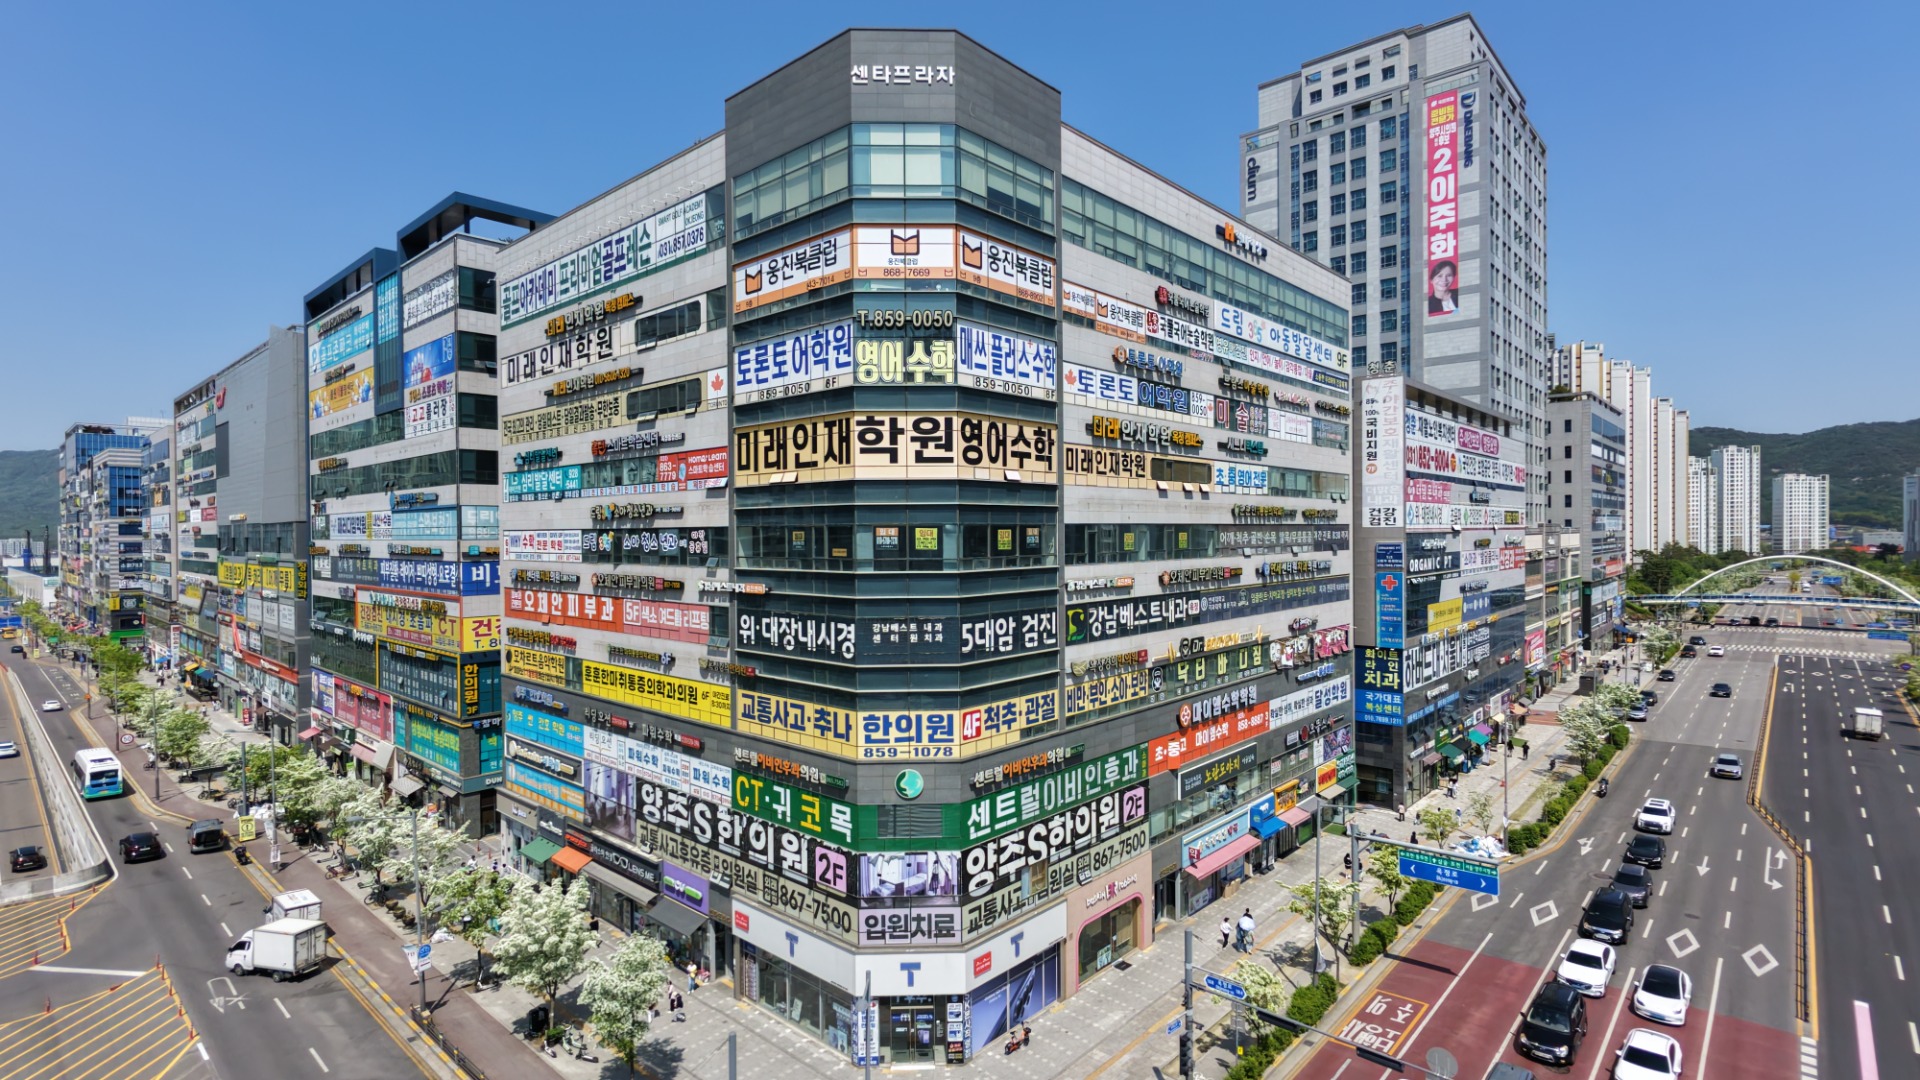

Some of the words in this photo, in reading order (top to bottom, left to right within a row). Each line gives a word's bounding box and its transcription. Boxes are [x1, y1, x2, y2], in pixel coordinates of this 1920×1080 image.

[850, 64, 956, 85] 센타프라자
[1463, 109, 1474, 169] DAEBANG
[1433, 147, 1453, 174] 2
[1430, 173, 1457, 260] 이주화
[766, 238, 837, 286] 웅진북클럽
[883, 268, 930, 278] 868-7669
[987, 244, 1053, 289] 웅진북클럽
[856, 309, 953, 328] T.859-0050
[1109, 303, 1144, 328] 웅진북클럽
[1221, 307, 1243, 337] 드림
[1269, 326, 1333, 362] 아동발달센터
[1336, 351, 1347, 369] 9F
[507, 325, 613, 383] 미래인재학원
[855, 339, 956, 385] 영어수학
[959, 326, 1056, 387] 매쓰플러스수학
[1127, 348, 1155, 371] 토론토
[1158, 355, 1183, 378] 어학원
[1367, 360, 1397, 375] 청춘
[759, 382, 810, 400] 859-0050
[825, 377, 838, 389] 8F
[974, 376, 1031, 396] 859-0050
[1045, 389, 1056, 399] 8F
[1191, 404, 1208, 417] 0050
[1216, 398, 1249, 433] 미술
[1093, 415, 1172, 446] 미래인재학원
[1172, 429, 1202, 447] 옥정캠퍼스
[1366, 417, 1378, 461] 국비지원
[659, 471, 677, 480] 7779
[688, 462, 725, 474] 스마트학습센터
[1065, 447, 1146, 478] 미래인재학원
[521, 469, 563, 491] 심리발달센터
[1368, 507, 1398, 517] 건강
[1368, 516, 1398, 527] 검진
[522, 533, 535, 550] 수학
[582, 533, 597, 551] 드림
[1410, 557, 1442, 573] ORGANIC
[1443, 555, 1453, 569] PT
[597, 575, 655, 590] 오체안피부과의원
[524, 592, 614, 621] 오체안피부과
[625, 602, 640, 622] 5F
[641, 604, 657, 625] 색소
[658, 604, 683, 627] 여드름
[684, 607, 710, 631] 리프팅
[1088, 596, 1188, 637] 강남베스트내과
[438, 617, 457, 636] CT
[961, 617, 1017, 653] 5대암
[1021, 611, 1057, 648] 검진
[513, 649, 565, 673] 모차르트음악학원
[660, 652, 671, 665] 6F
[1364, 648, 1400, 661] 화이트
[1364, 659, 1399, 672] 라인
[464, 663, 478, 704] 한의원
[584, 665, 698, 704] 훈훈한마취통증의학과의원
[701, 690, 710, 701] 6F
[1066, 671, 1148, 713] 비만·부인·소아·보약
[1363, 670, 1401, 690] 치과
[1314, 681, 1348, 710] 달성학원
[1365, 692, 1402, 704] 국가대표
[1365, 702, 1402, 715] 복싱센터
[466, 705, 478, 715] 3F
[984, 691, 1056, 734] 척추·관절
[642, 722, 673, 744] 파워수학
[862, 713, 955, 744] 한의원
[962, 710, 982, 738] 4F
[628, 746, 659, 769] 파워수학
[863, 746, 954, 758] 859-1078
[733, 747, 819, 784] 센트럴이비인후과의원
[974, 747, 1065, 788] 센트럴이비인후과의원
[693, 767, 731, 791] 파워수학
[967, 749, 1139, 840] 센트럴이비인후과
[641, 782, 809, 886] 양주S한의원
[818, 853, 844, 887] 2F
[966, 791, 1121, 897] 양주S한의원
[1125, 794, 1143, 822] 2F
[1093, 830, 1147, 872] 867-7500
[721, 859, 758, 895] 입원실
[1436, 867, 1458, 878] 옥정로
[779, 885, 852, 933] 867-7500
[864, 914, 956, 940] 입원치료
[785, 931, 799, 957] T
[1010, 931, 1025, 958] T
[900, 962, 922, 987] T
[1365, 994, 1415, 1025] 주의
